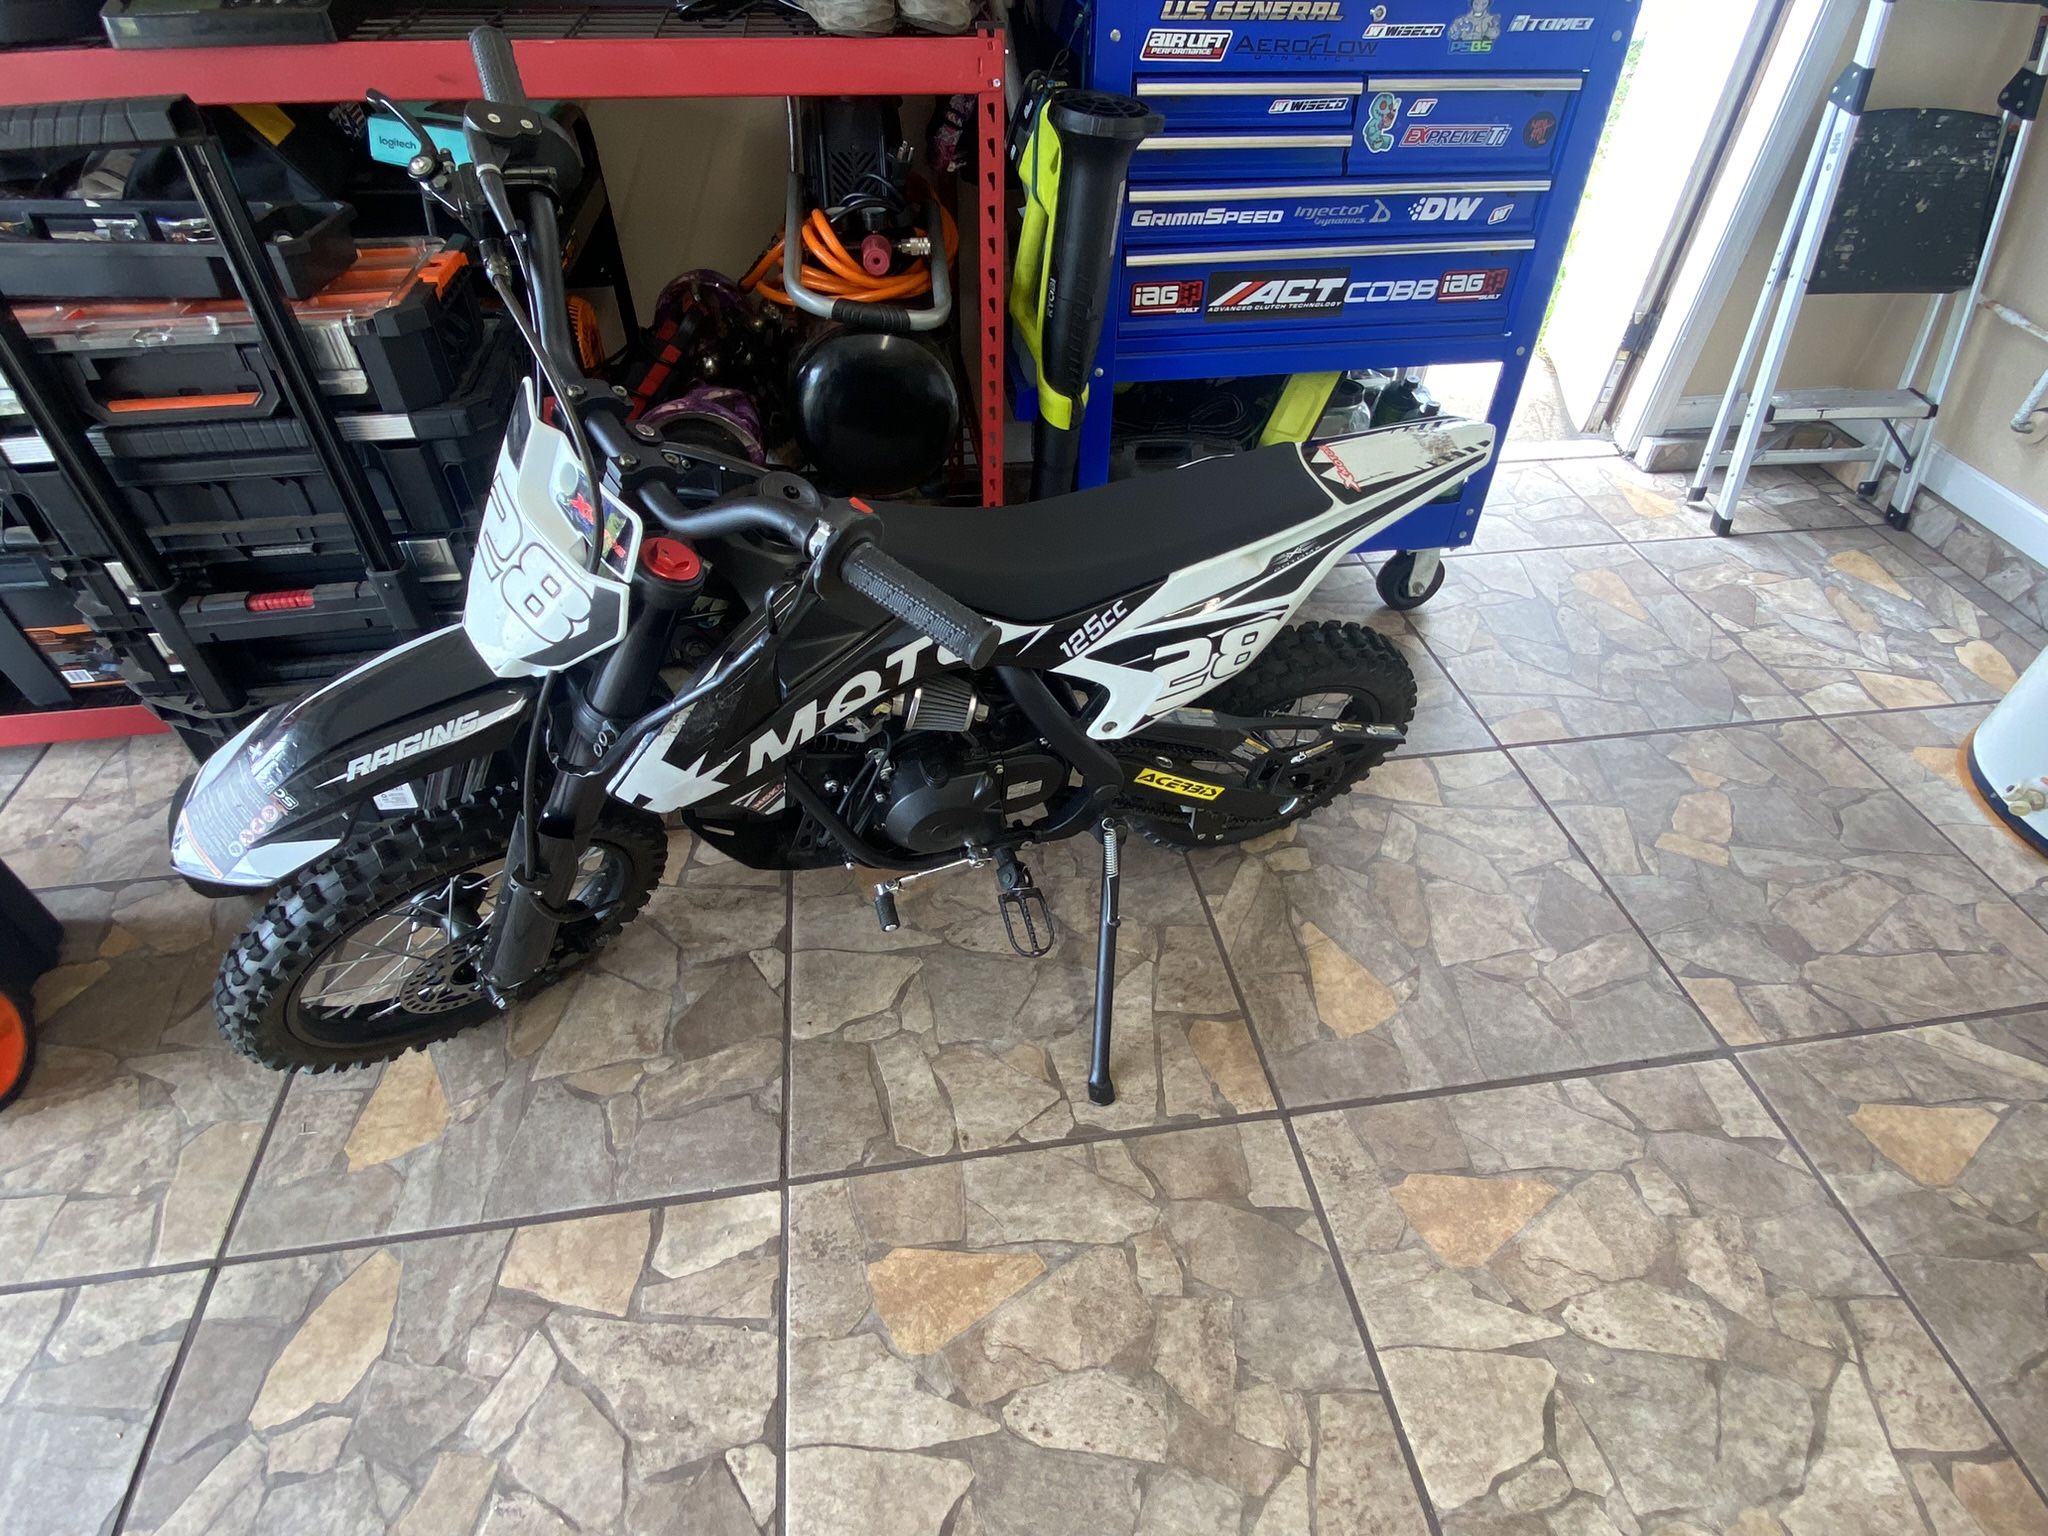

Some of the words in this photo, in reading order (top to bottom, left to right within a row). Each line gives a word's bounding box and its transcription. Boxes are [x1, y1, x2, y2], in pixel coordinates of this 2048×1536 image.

[1160, 1, 1207, 20] U.S.
[1211, 1, 1344, 21] GENERAL
[1150, 47, 1213, 55] PERFORMANCE
[1187, 33, 1229, 48] LIFT
[1233, 33, 1379, 55] AEROFLOW
[379, 136, 417, 150] logitech
[1403, 126, 1486, 144] EXPREME
[1294, 205, 1369, 220] Injector
[1418, 197, 1484, 221] DW
[1314, 217, 1366, 226] Dynamics
[1047, 278, 1056, 318] RYOBI
[1240, 277, 1348, 306] ACT
[1344, 279, 1440, 303] COBB
[1207, 305, 1253, 313] ADVANCED
[1254, 303, 1286, 311] CLUTCH
[1288, 301, 1342, 309] TECHNOLOGY
[479, 473, 592, 643] 28
[1153, 617, 1281, 701] 28
[347, 710, 480, 783] RACING
[1137, 773, 1217, 797] ACERBIS
